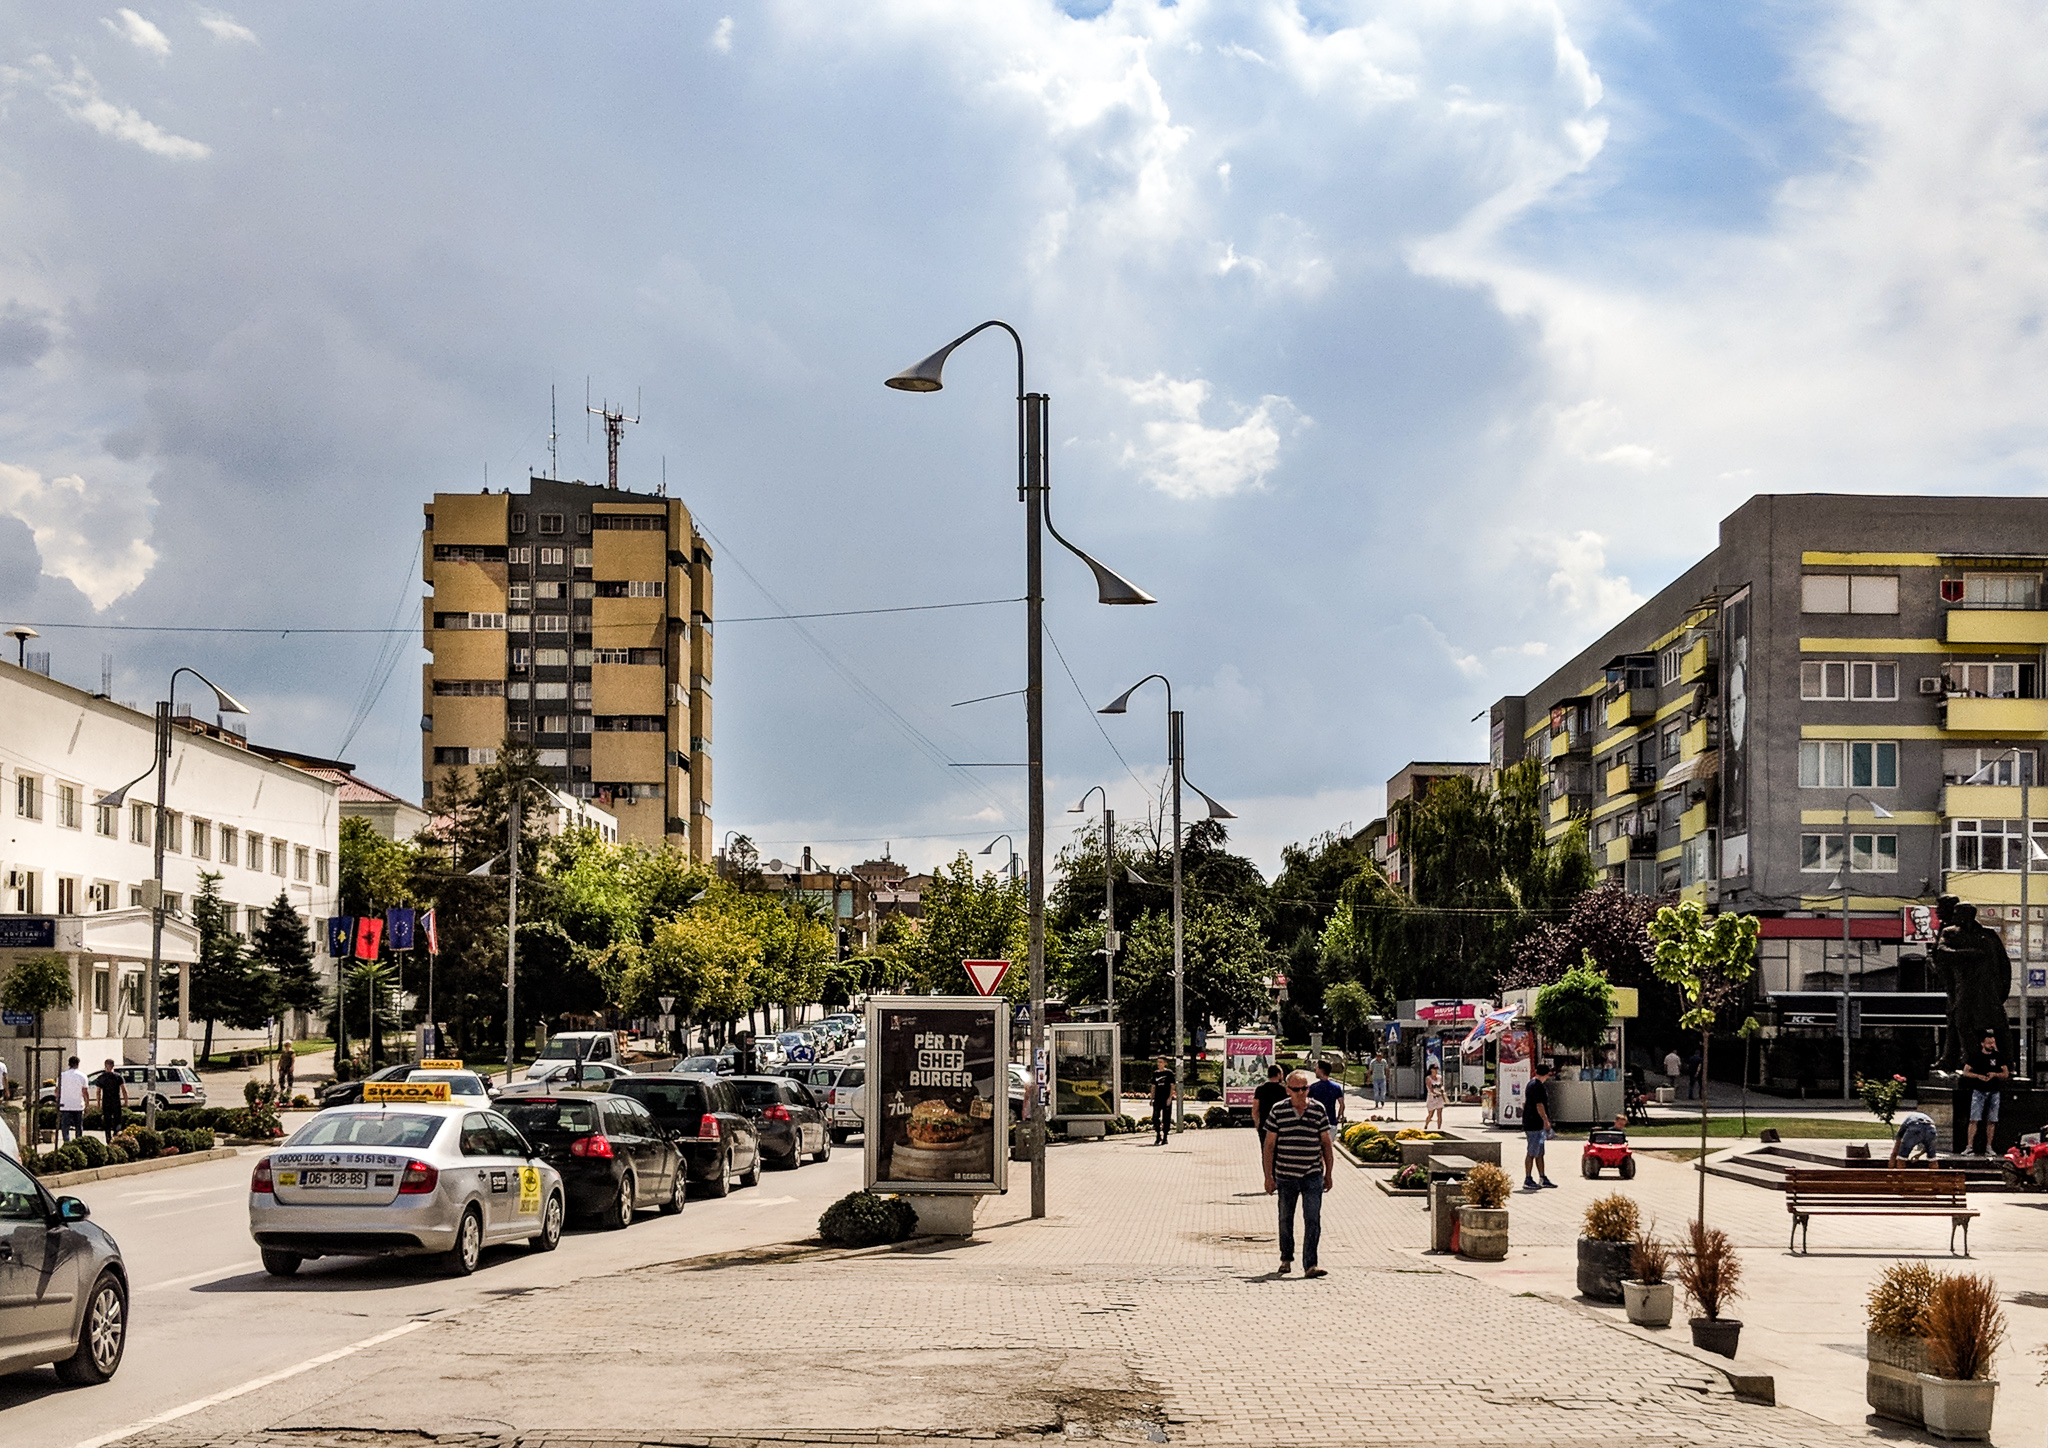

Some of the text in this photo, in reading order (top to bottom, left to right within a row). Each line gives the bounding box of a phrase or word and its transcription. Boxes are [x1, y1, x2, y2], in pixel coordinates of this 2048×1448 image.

[914, 1031, 969, 1050] PËR TY
[1234, 1042, 1268, 1055] Wedding
[920, 1052, 962, 1068] SHEF
[909, 1070, 973, 1087] BURGER
[368, 1085, 446, 1099] SHAQA 44
[305, 1154, 325, 1162] 1000
